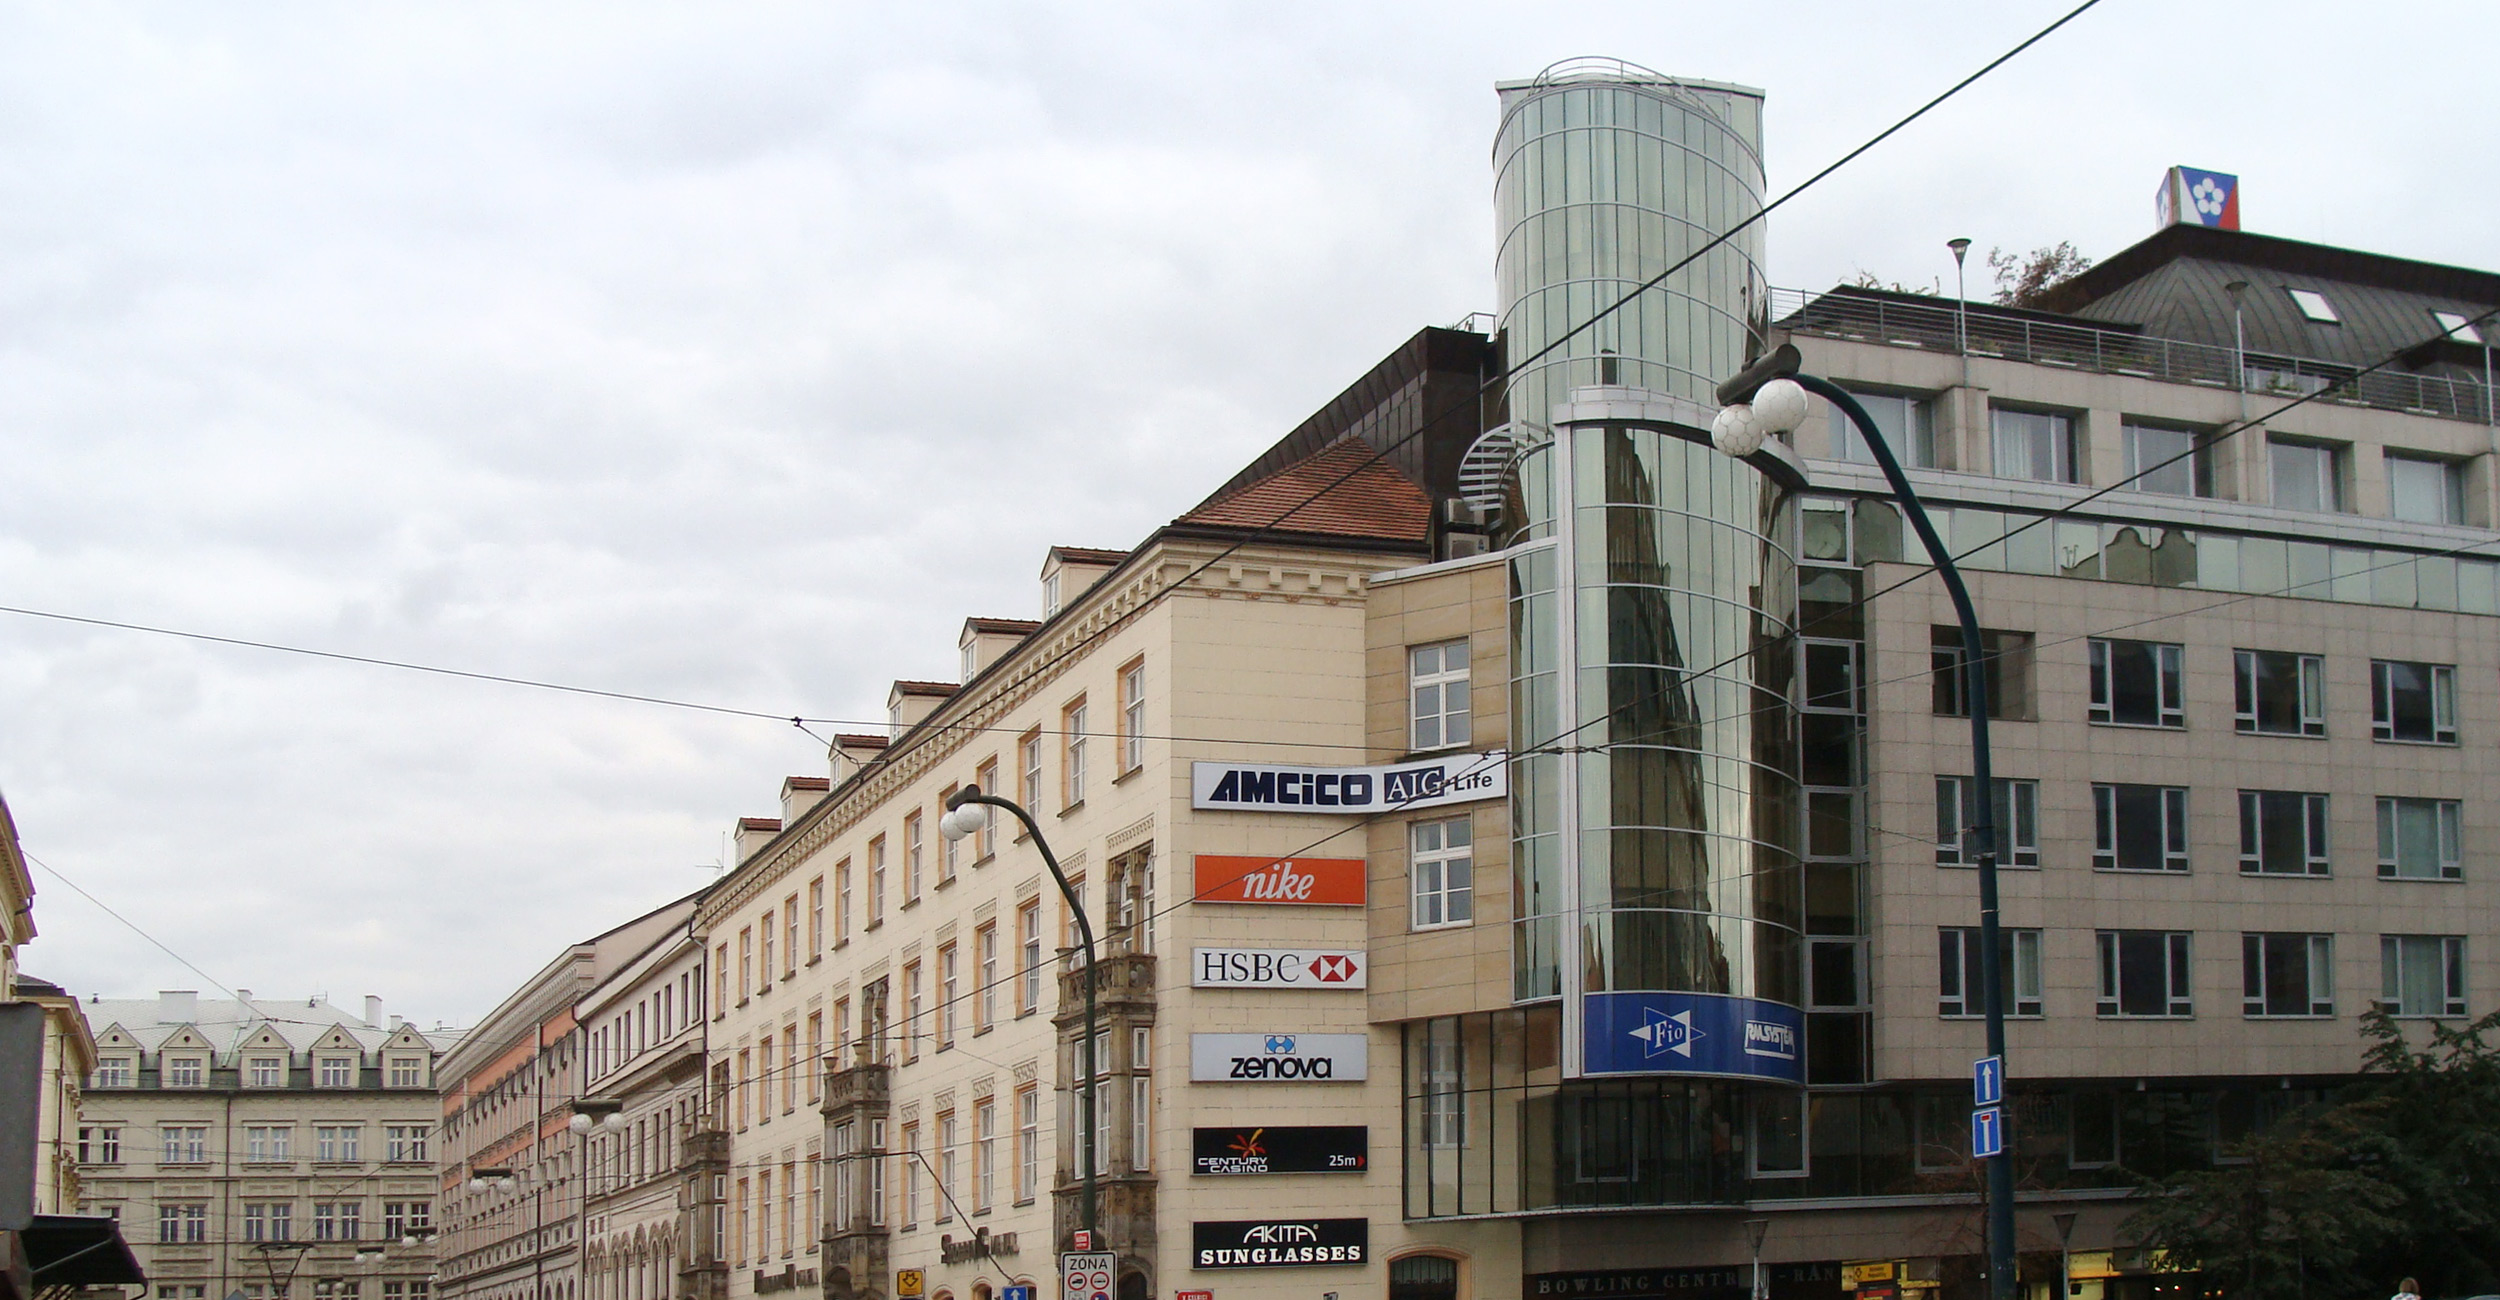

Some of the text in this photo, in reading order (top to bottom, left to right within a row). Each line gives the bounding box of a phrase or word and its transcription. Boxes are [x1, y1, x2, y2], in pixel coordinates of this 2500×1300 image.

[1387, 770, 1493, 801] AIG Life
[1242, 861, 1315, 900] nike
[1201, 952, 1301, 983] HSBC
[1654, 1020, 1684, 1049] Fio
[1230, 1056, 1332, 1079] zenova
[1197, 1157, 1269, 1167] CENTURY
[1209, 1165, 1269, 1174] CASINO
[1328, 1154, 1357, 1167] 25m
[1243, 1224, 1318, 1244] AKITA
[1069, 1255, 1108, 1271] ZÓNA
[1200, 1245, 1362, 1265] SUNGLASSES
[1537, 1275, 1650, 1294] BOWLING
